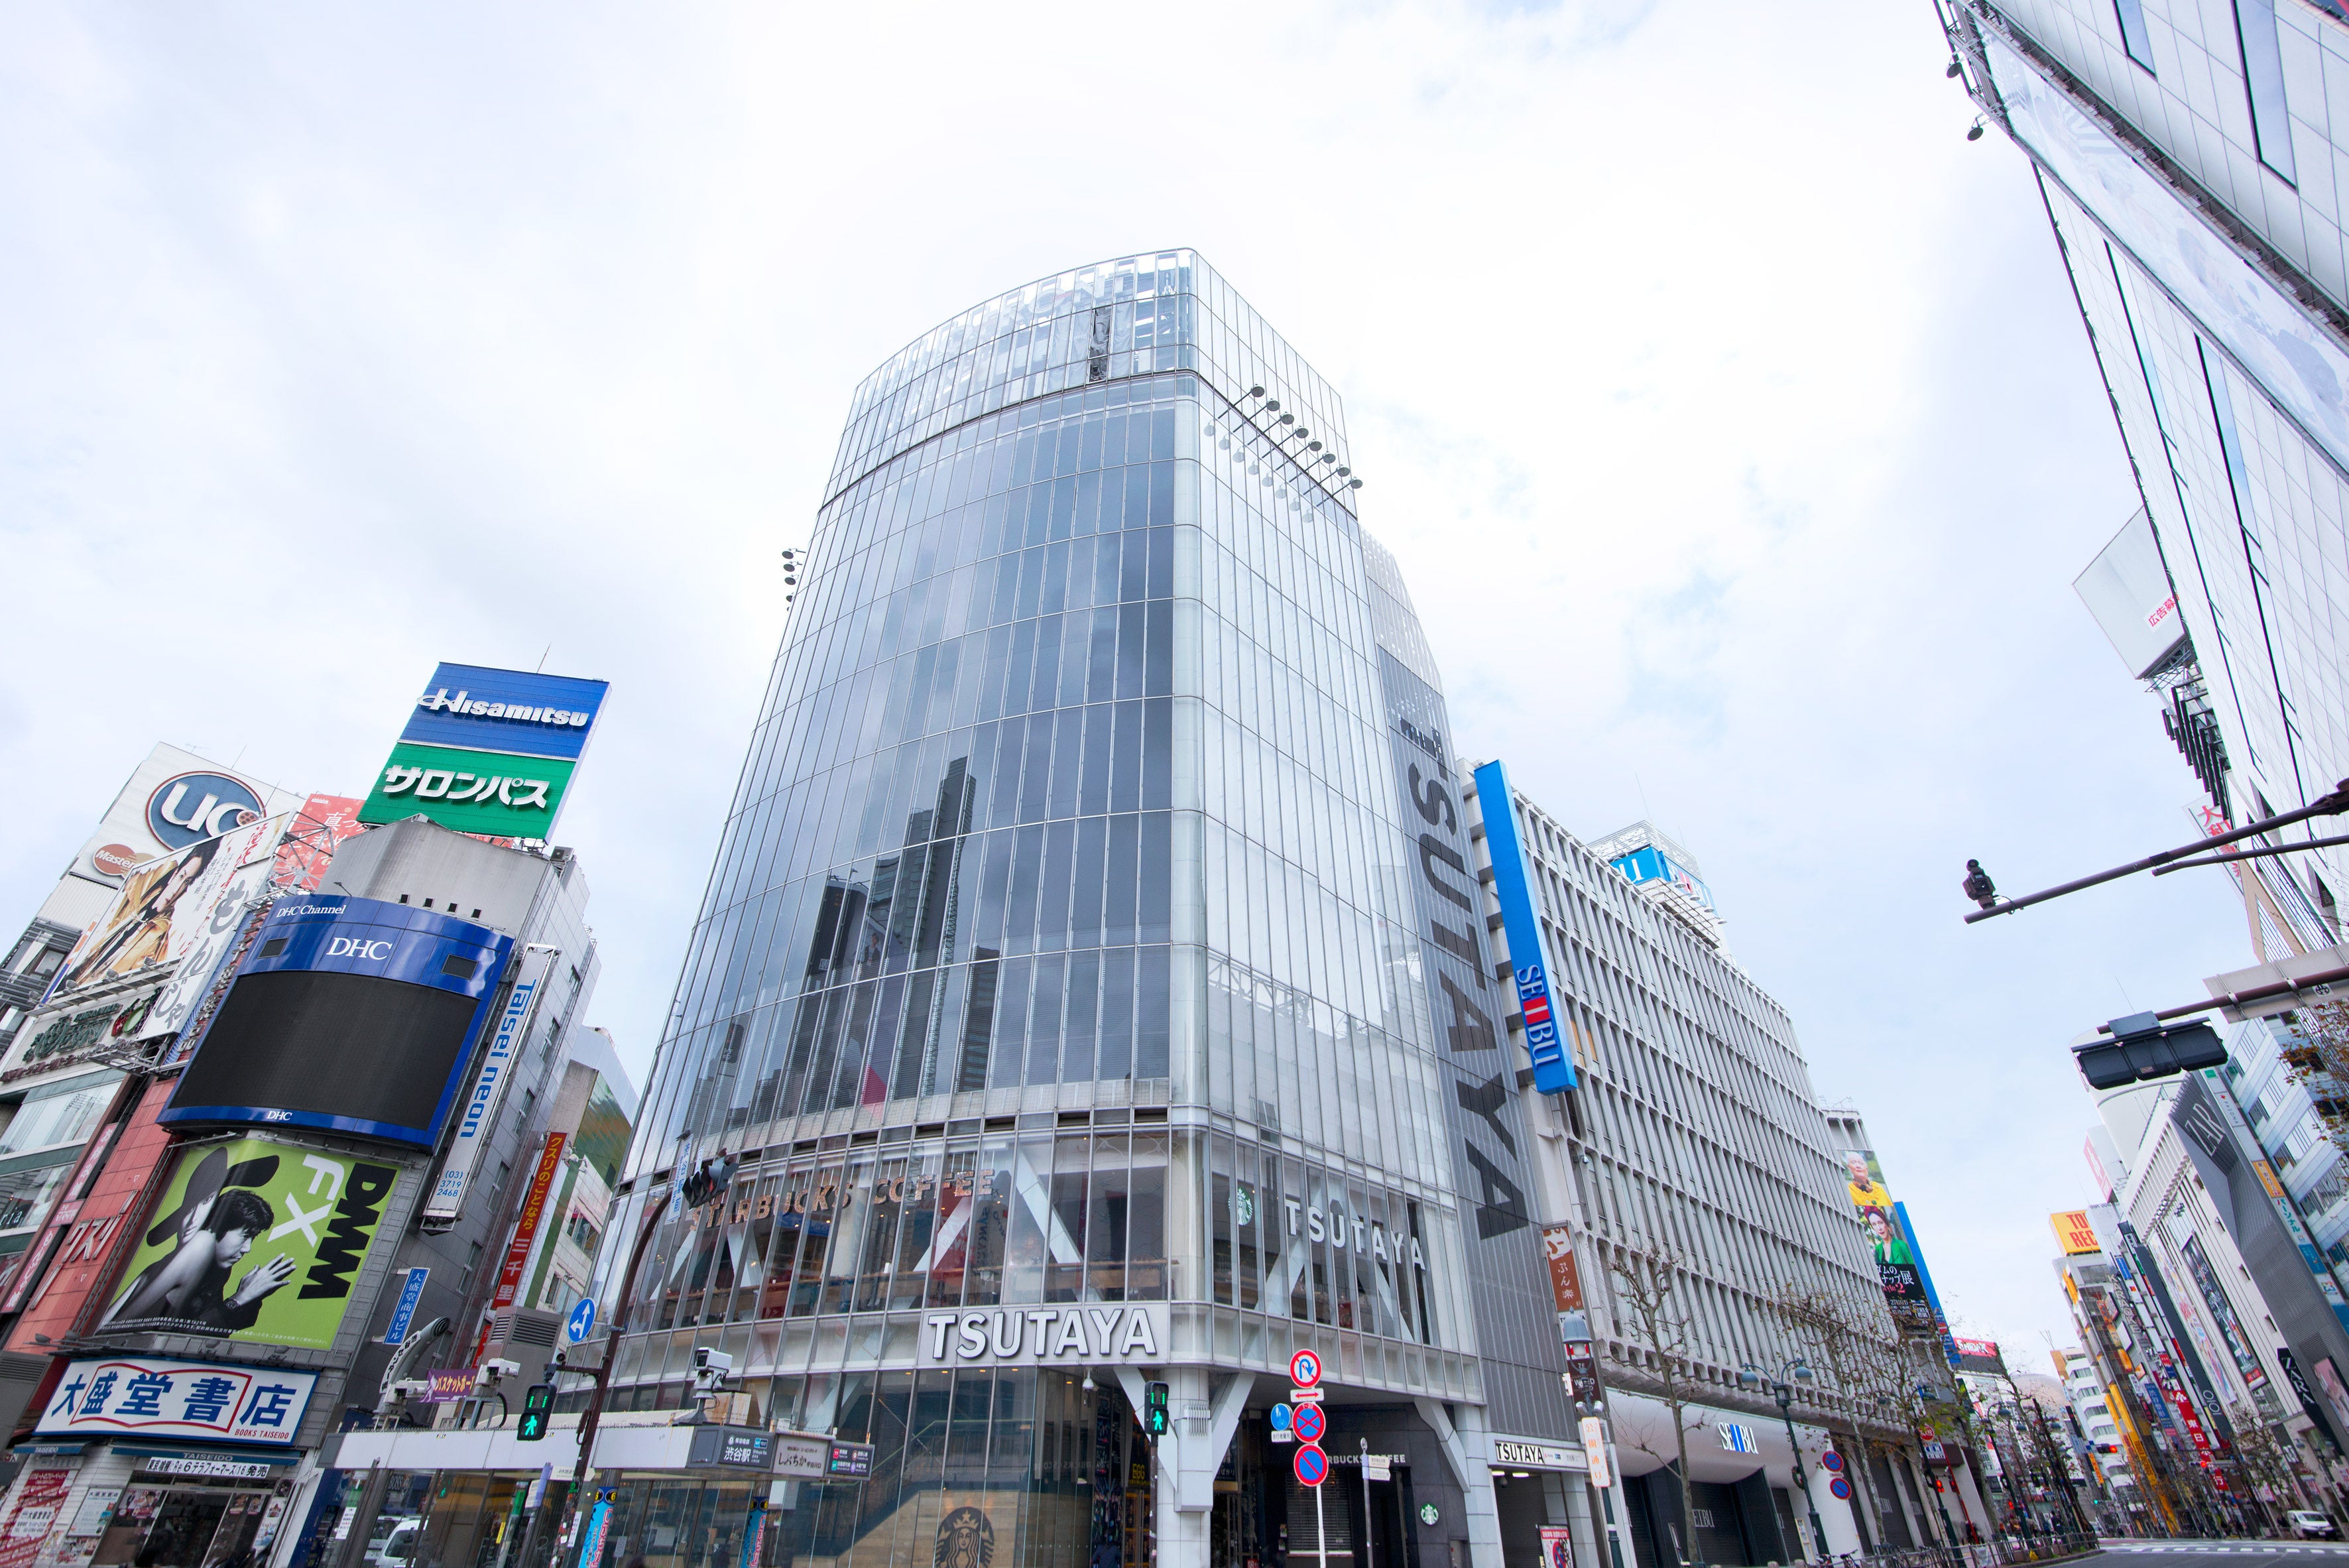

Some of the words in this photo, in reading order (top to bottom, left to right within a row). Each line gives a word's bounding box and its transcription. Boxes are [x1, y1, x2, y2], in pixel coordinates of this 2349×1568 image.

[2148, 594, 2179, 627] 広告募
[416, 688, 589, 727] Hisamitsu
[383, 765, 550, 808] サロンパス
[276, 906, 300, 918] DHC
[300, 903, 347, 916] Channel
[155, 879, 249, 1030] もんじゃ
[326, 937, 393, 960] DHC
[1400, 717, 1529, 1238] TSUTAYA
[490, 979, 537, 1059] Taisei
[1516, 964, 1561, 1069] SEIBU
[267, 1110, 293, 1122] DHC
[459, 1066, 498, 1138] neon
[2224, 1101, 2239, 1125] PASONA
[436, 1188, 459, 1197] 2468
[440, 1179, 462, 1188] 3719
[444, 1170, 463, 1179] (03)
[522, 1136, 564, 1229] クスリのことなら
[267, 1154, 346, 1249] FX
[690, 1183, 853, 1231] STARBUCKS
[874, 1169, 994, 1205] COFFEE
[2276, 1199, 2301, 1233] パーソナル
[297, 1162, 398, 1300] DMM
[1284, 1198, 1427, 1270] TSUTAYA
[496, 1238, 530, 1301] 三千里
[389, 1272, 424, 1341] 大盛堂商事ビル
[2106, 1274, 2142, 1335] KARAOKE
[928, 1308, 1157, 1359] TSUTAYA
[51, 1370, 298, 1427] 大盛堂書店
[2281, 1357, 2315, 1404] ZARA
[234, 1428, 257, 1437] BOOKS
[259, 1429, 290, 1439] TAISEIDO
[1495, 1442, 1545, 1464] TSUTAYA
[1718, 1422, 1759, 1454] SEIBU
[182, 1453, 233, 1462] TAISEIDO
[183, 1462, 192, 1471] 6
[246, 1464, 268, 1477] 発売
[723, 1446, 752, 1463] 渋谷駅
[1132, 1463, 1145, 1480] EGG
[1692, 1509, 1715, 1528] EIBU
